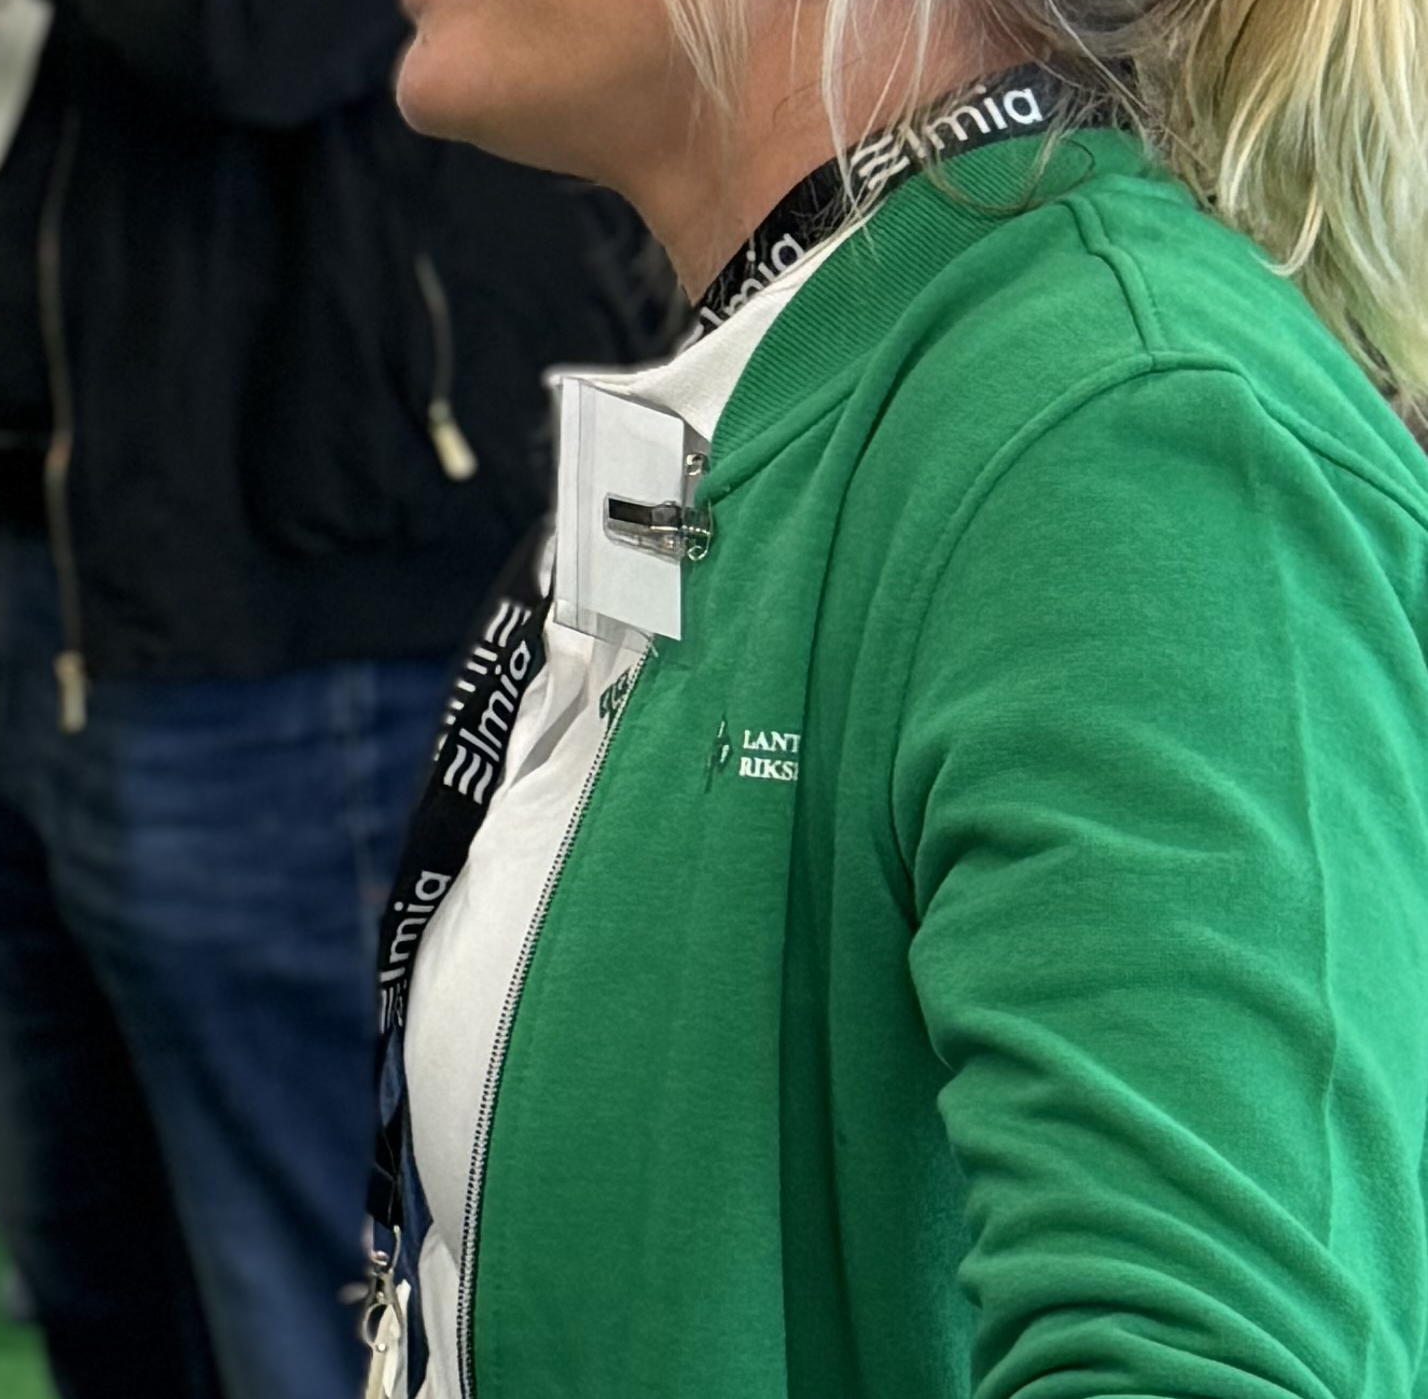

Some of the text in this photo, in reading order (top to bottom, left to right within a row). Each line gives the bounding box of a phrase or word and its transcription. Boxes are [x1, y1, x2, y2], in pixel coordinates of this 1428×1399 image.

[850, 83, 1045, 192] Elmia
[678, 231, 806, 350] lmia
[443, 639, 532, 805] Elmia
